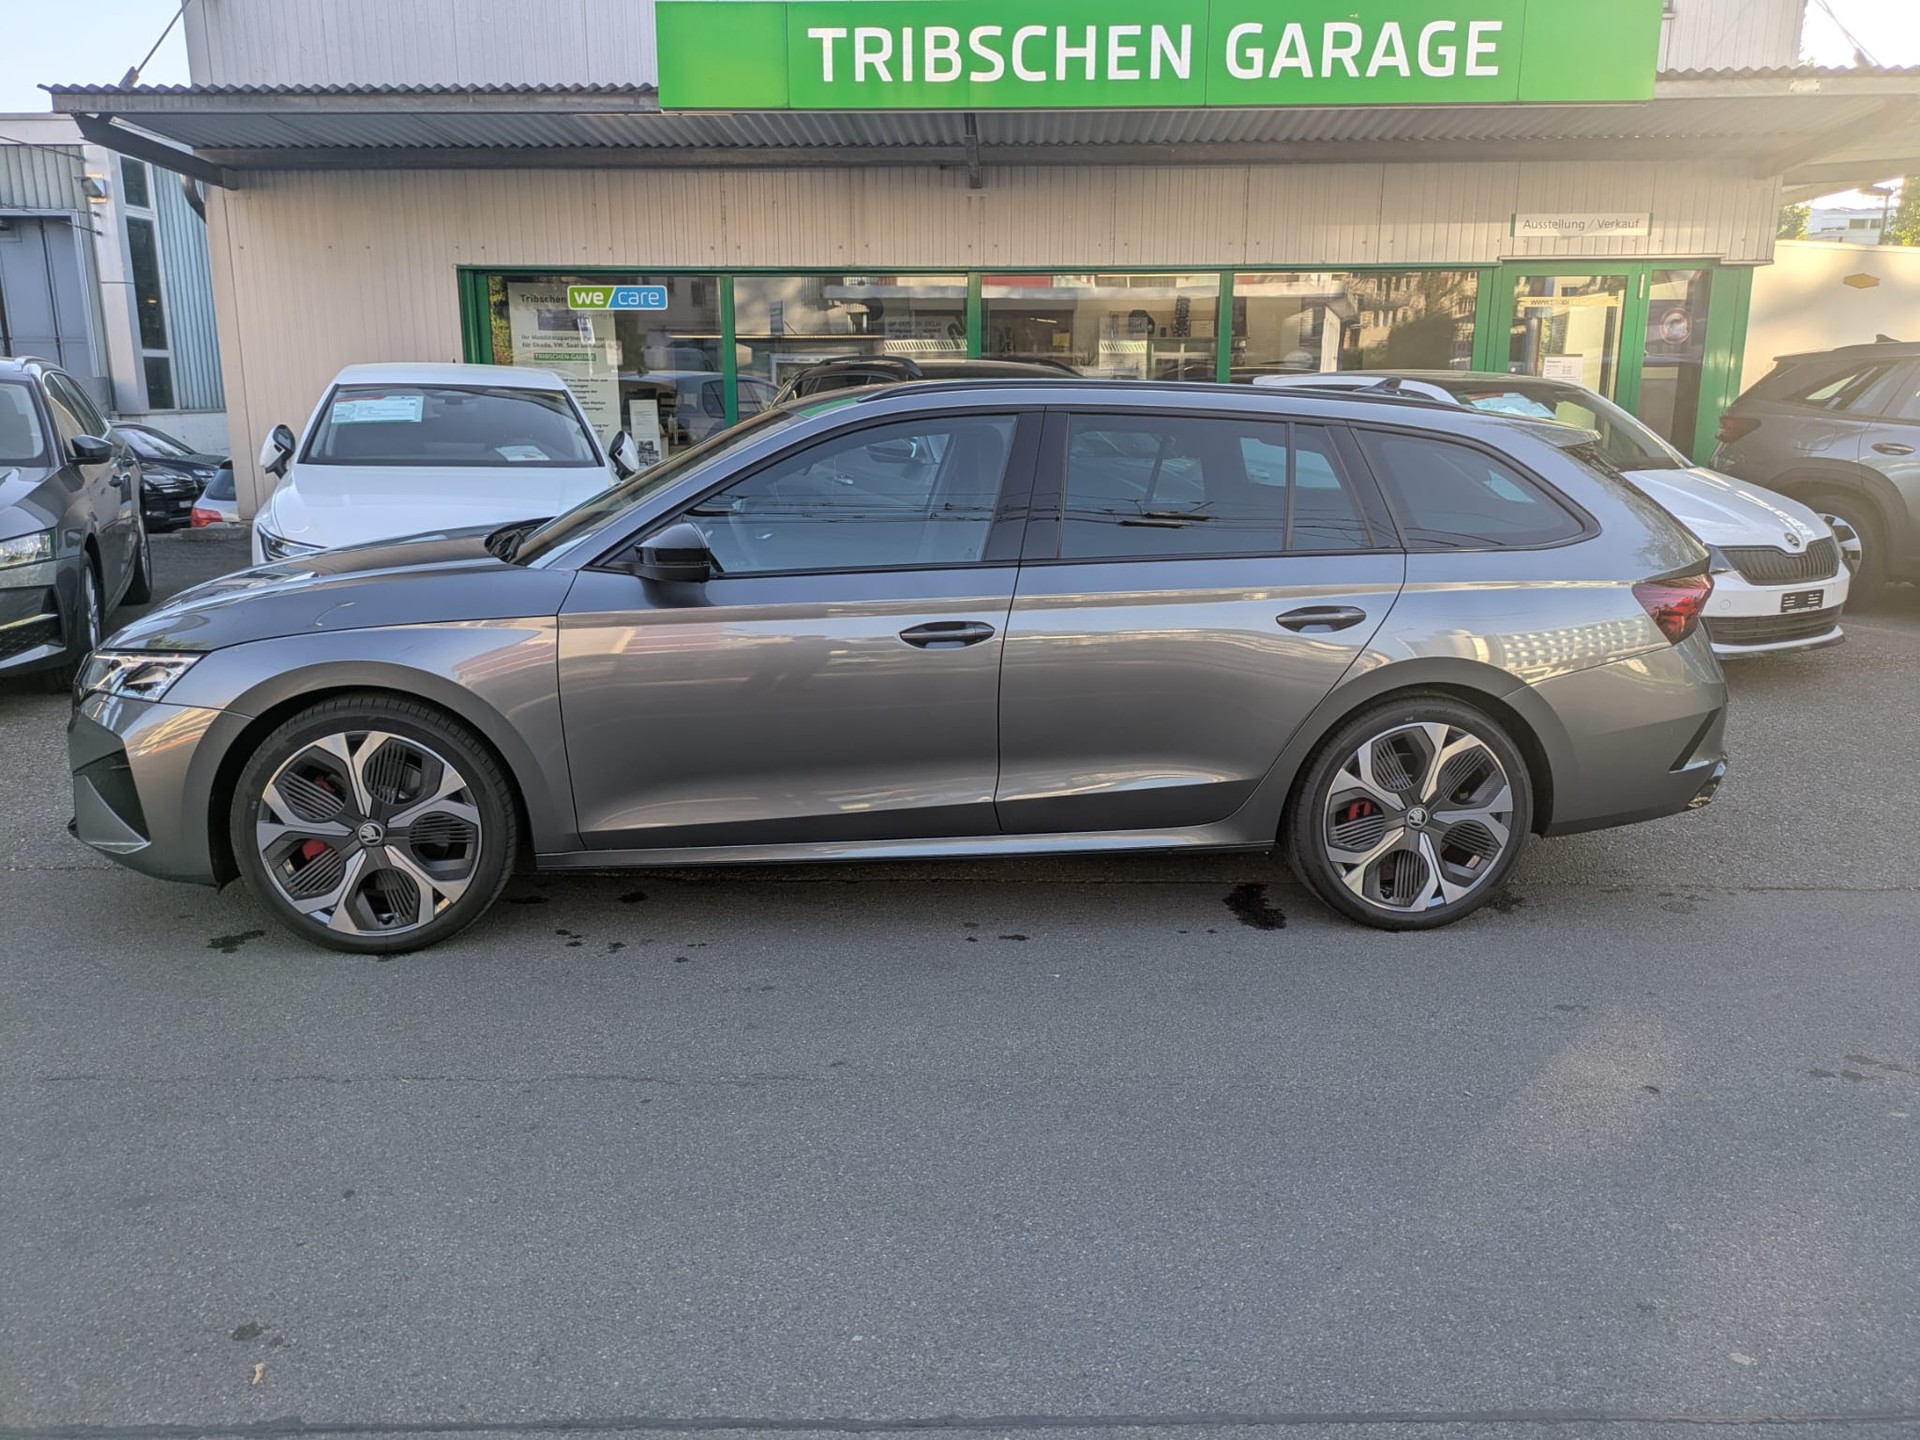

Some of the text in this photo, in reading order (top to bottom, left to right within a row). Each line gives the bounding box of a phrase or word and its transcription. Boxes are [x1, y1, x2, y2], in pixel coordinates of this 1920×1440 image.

[807, 20, 1503, 82] TRIBSCHEN GARAGE
[1523, 219, 1585, 231] Ausstellung
[1597, 218, 1640, 229] Verkauf
[520, 294, 567, 303] Tribschen
[574, 291, 660, 305] we care
